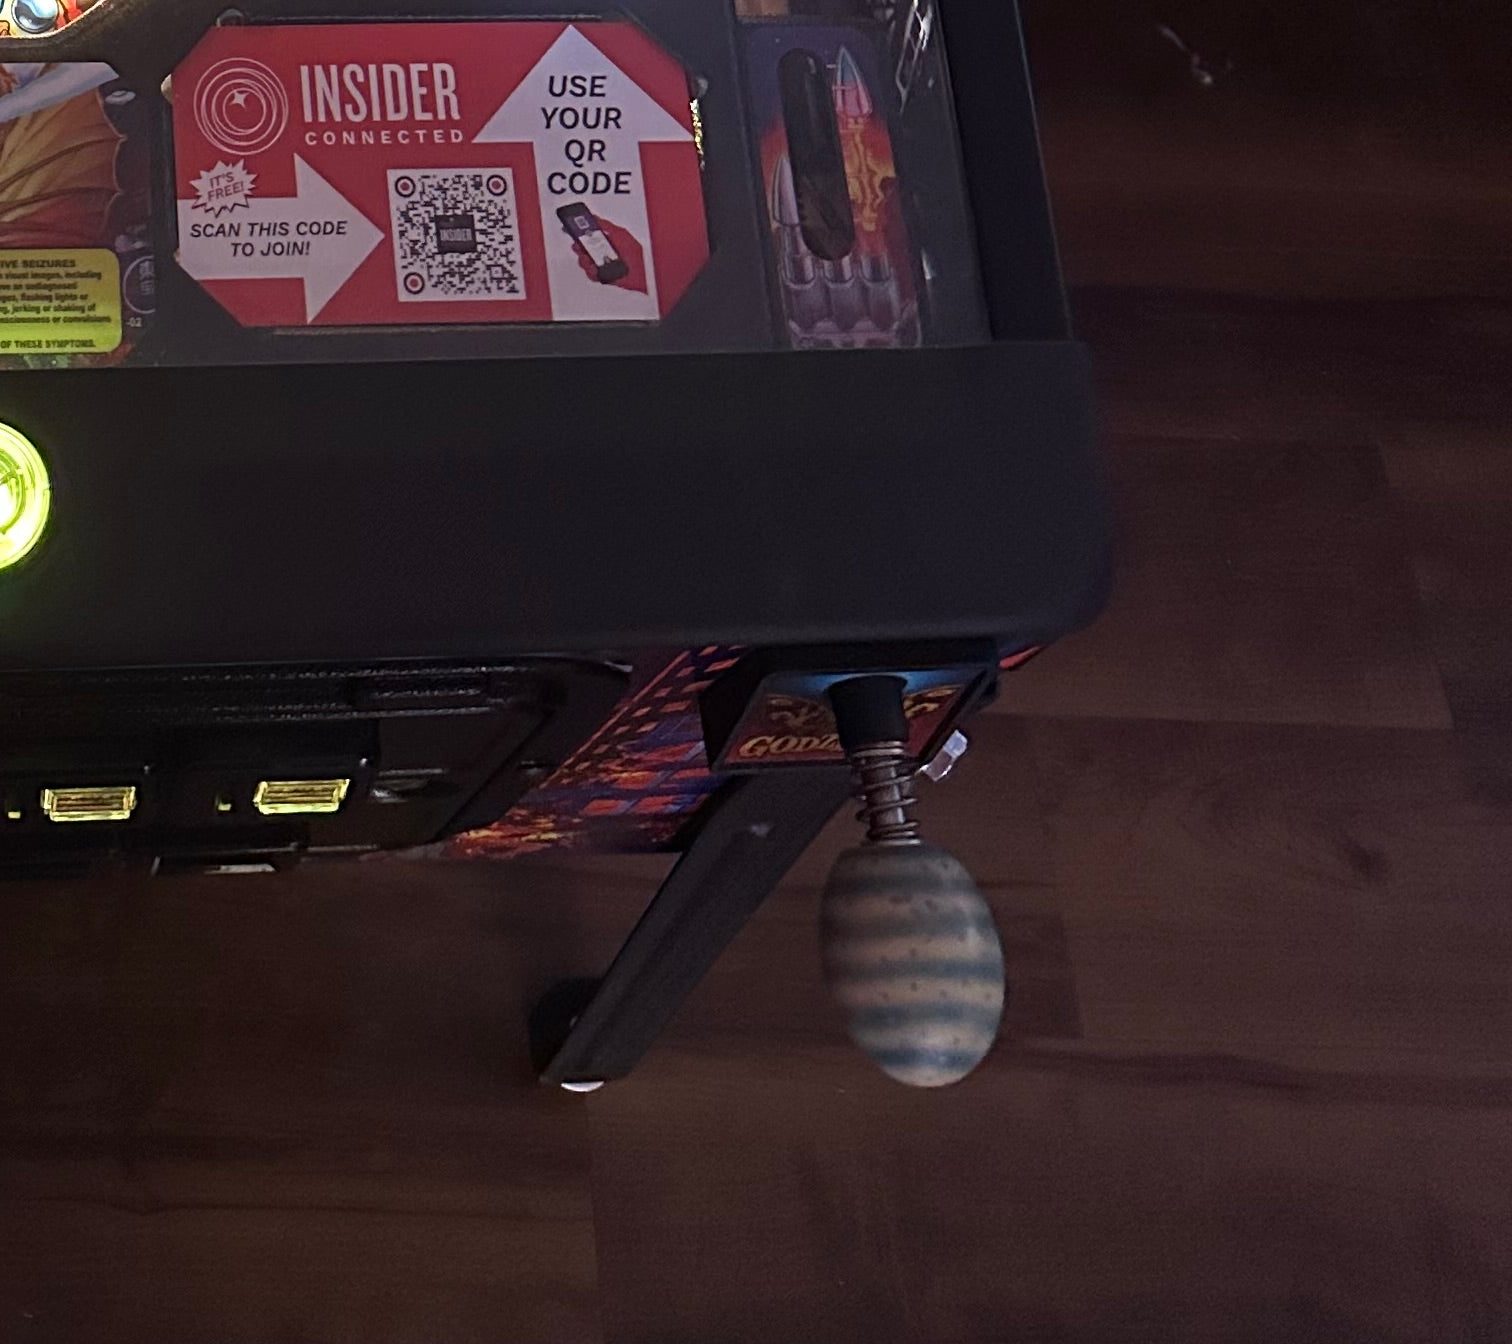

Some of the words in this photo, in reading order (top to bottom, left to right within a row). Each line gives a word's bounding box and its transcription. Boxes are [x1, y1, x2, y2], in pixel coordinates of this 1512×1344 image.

[300, 62, 462, 124] INSIDER
[548, 75, 607, 98] USE
[541, 107, 622, 130] YOUR
[305, 129, 464, 145] CONNECTED
[564, 138, 606, 164] QR
[209, 172, 234, 188] IT'S
[547, 171, 633, 195] CODE
[207, 181, 245, 202] FREE!
[190, 222, 241, 238] SCAN
[248, 221, 290, 237] THIS
[296, 220, 348, 236] CODE
[440, 227, 473, 244] INSIDER
[231, 242, 255, 257] TO
[260, 241, 311, 256] JOIN!
[22, 259, 76, 269] SEIZURES
